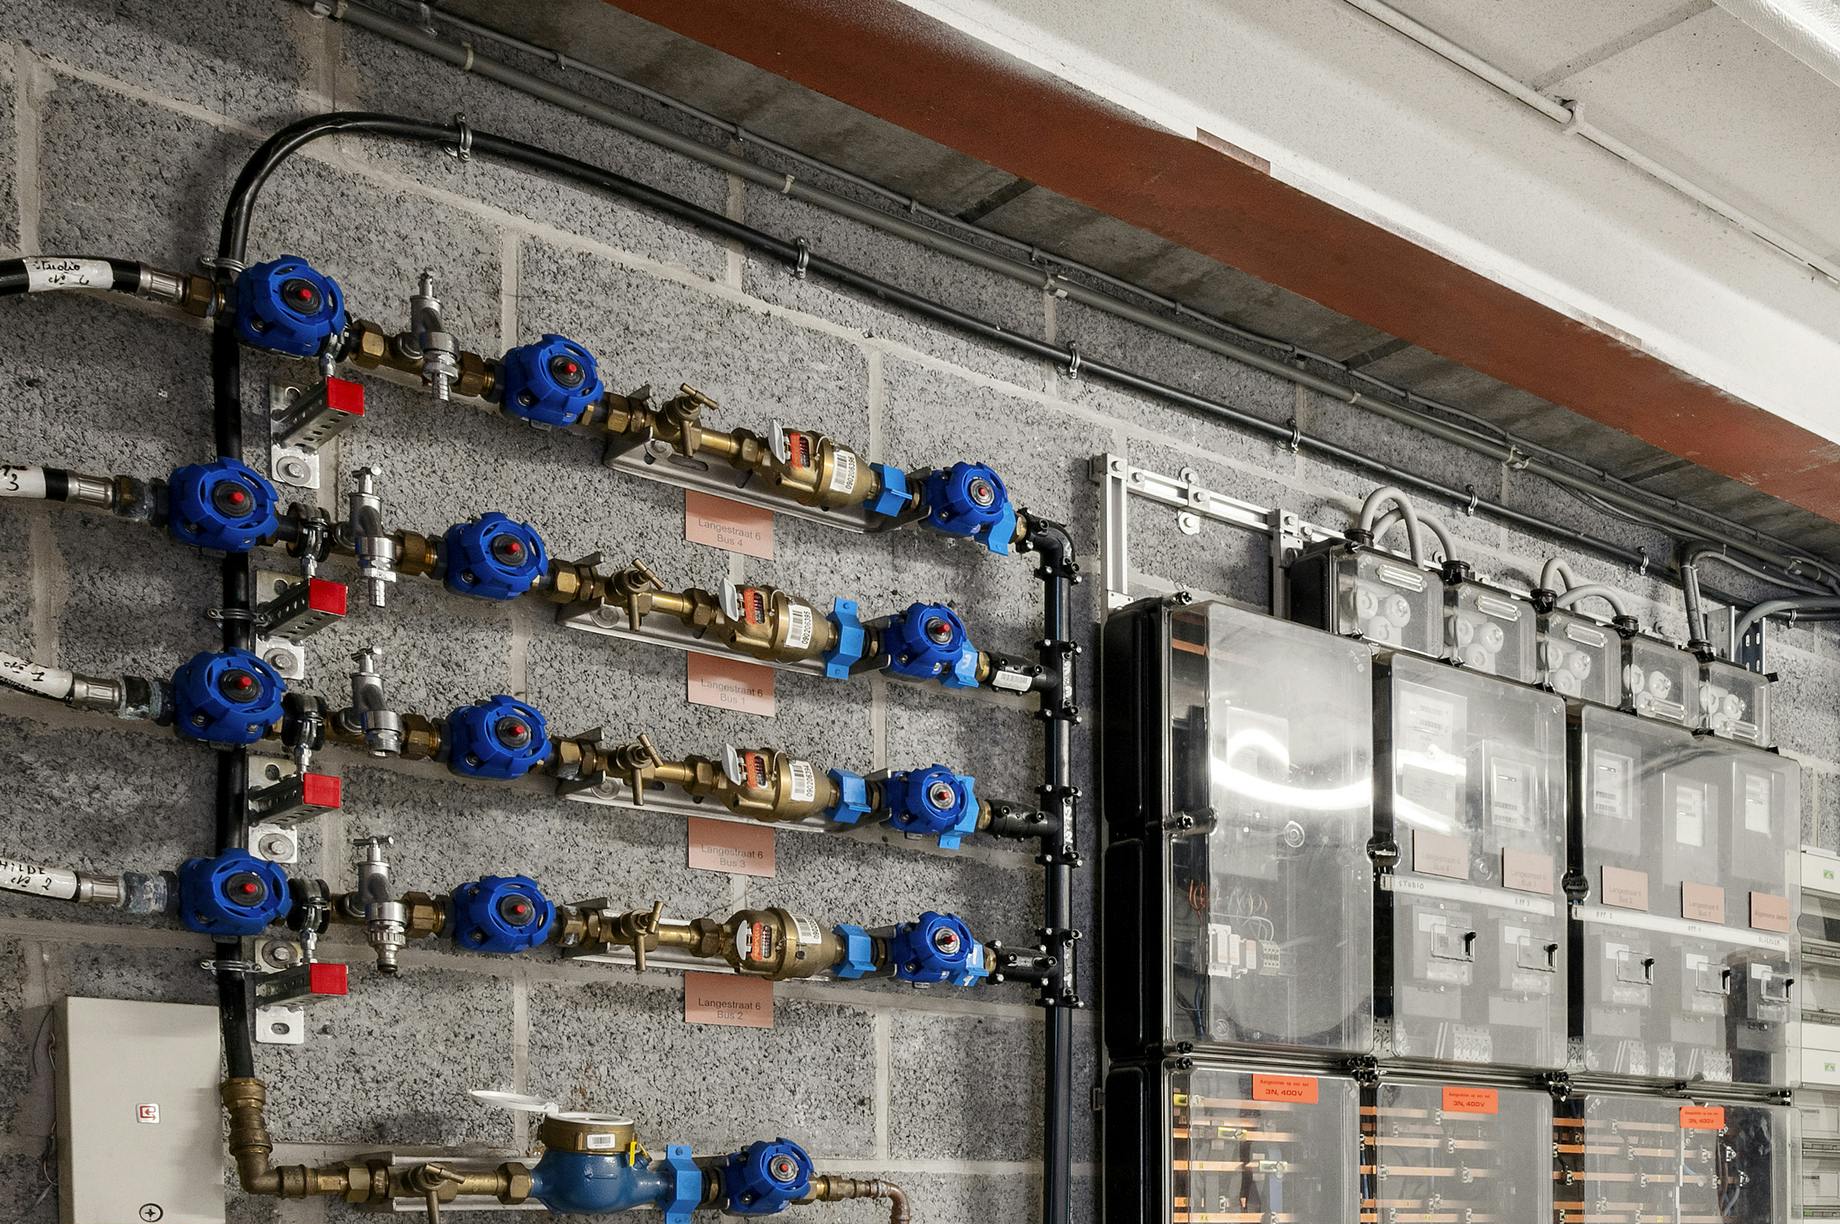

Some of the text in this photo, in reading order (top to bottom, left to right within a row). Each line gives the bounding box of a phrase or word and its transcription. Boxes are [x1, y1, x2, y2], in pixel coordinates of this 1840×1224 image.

[698, 519, 753, 539] Langestraat
[717, 533, 735, 545] Bus
[701, 678, 763, 697] Langestraat 6
[720, 693, 737, 704] Bus
[701, 843, 763, 859] Langestraat 6
[720, 857, 737, 867] Bus
[698, 998, 761, 1010] Langestraat 6
[717, 1010, 743, 1020] Bus 2
